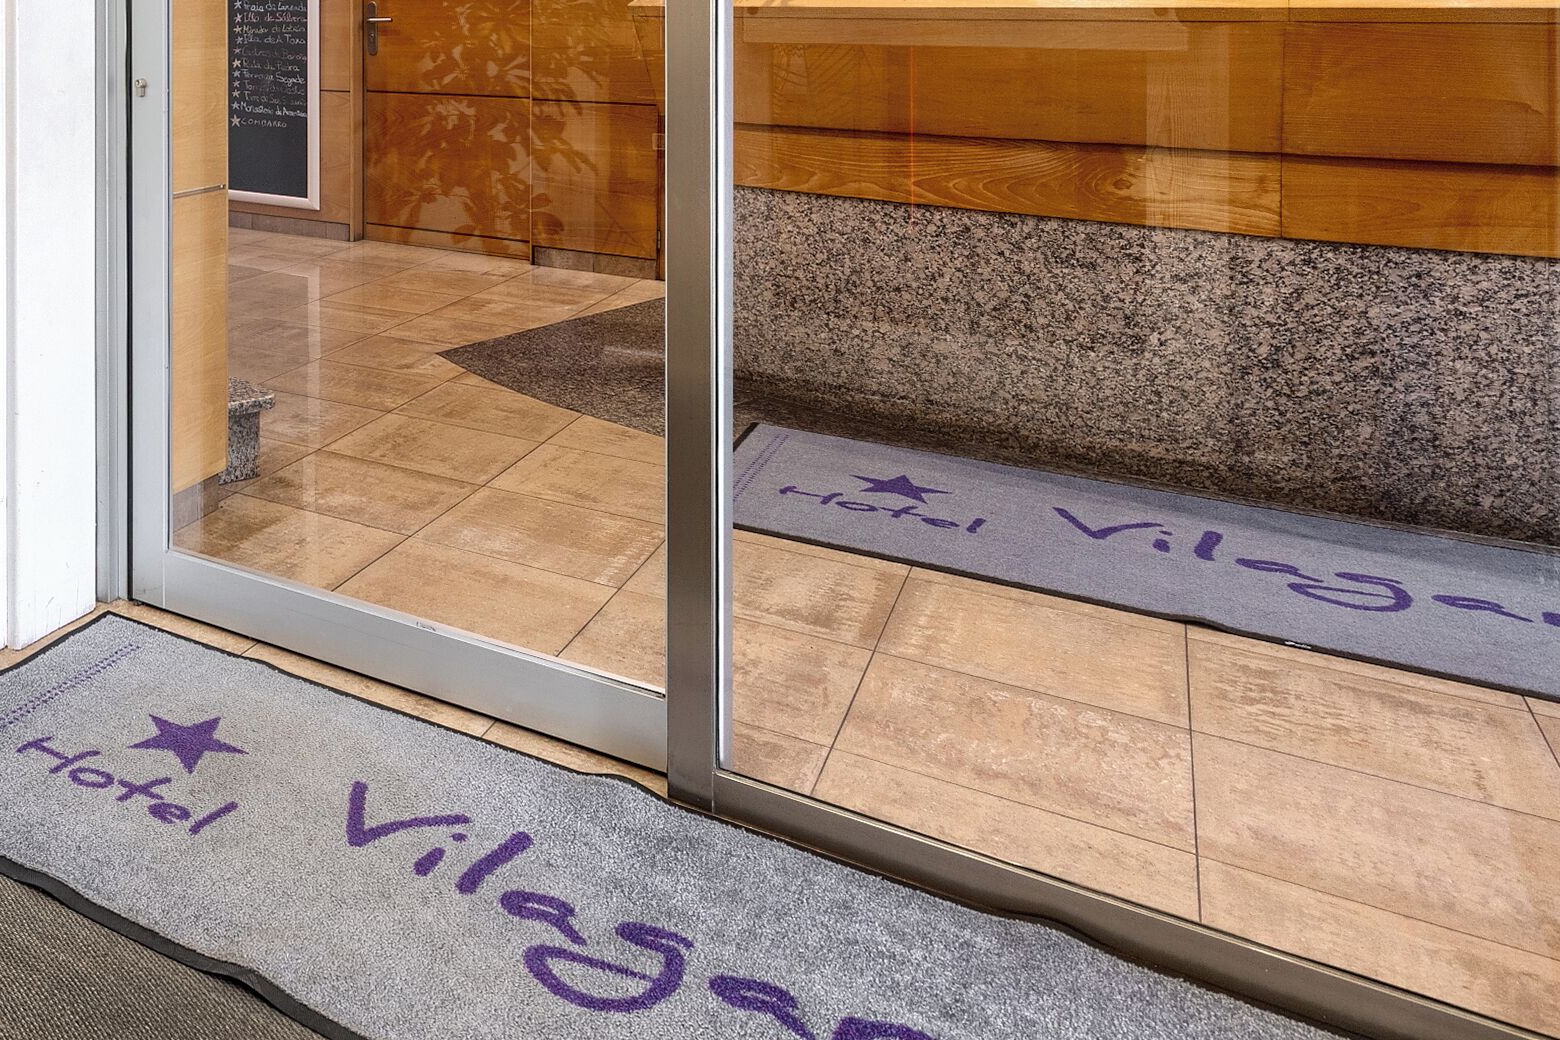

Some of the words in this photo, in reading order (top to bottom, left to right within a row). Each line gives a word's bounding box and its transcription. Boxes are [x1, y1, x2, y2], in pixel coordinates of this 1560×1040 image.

[778, 484, 986, 535] Hotel
[1052, 506, 1560, 626] Vilaga
[16, 735, 238, 835] Hotel
